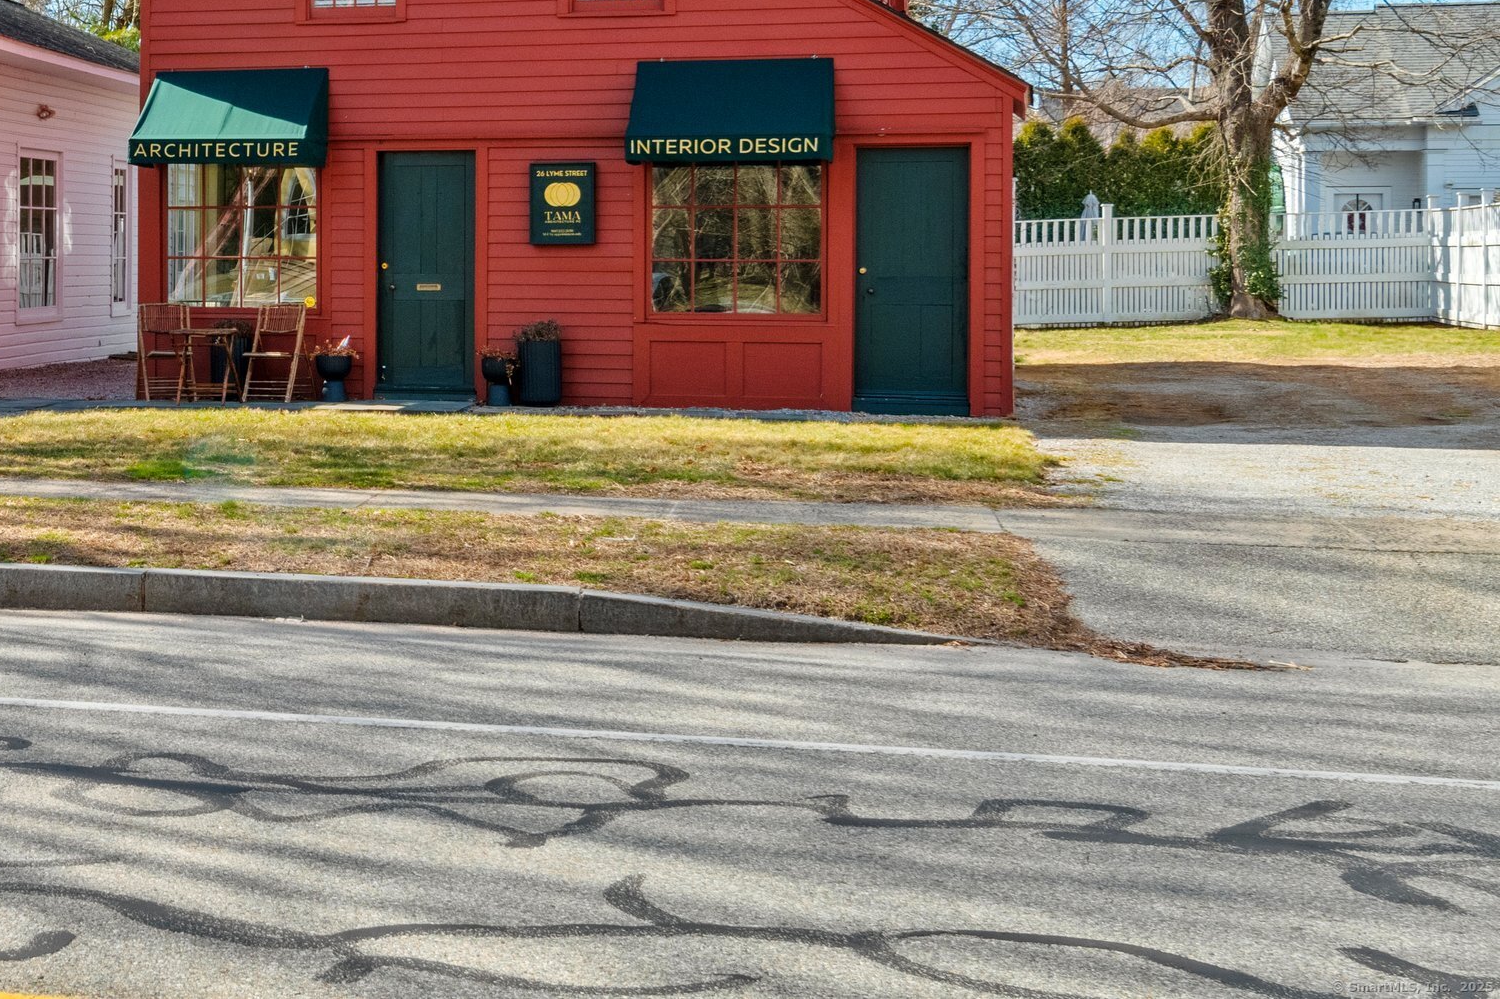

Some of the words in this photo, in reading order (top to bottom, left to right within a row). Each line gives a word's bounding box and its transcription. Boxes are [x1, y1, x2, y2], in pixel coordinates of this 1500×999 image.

[133, 142, 299, 158] ARCHITECTURE
[630, 138, 732, 155] INTERIOR
[739, 137, 819, 154] DESIGN
[565, 169, 588, 177] STREET
[544, 211, 581, 221] TAMA
